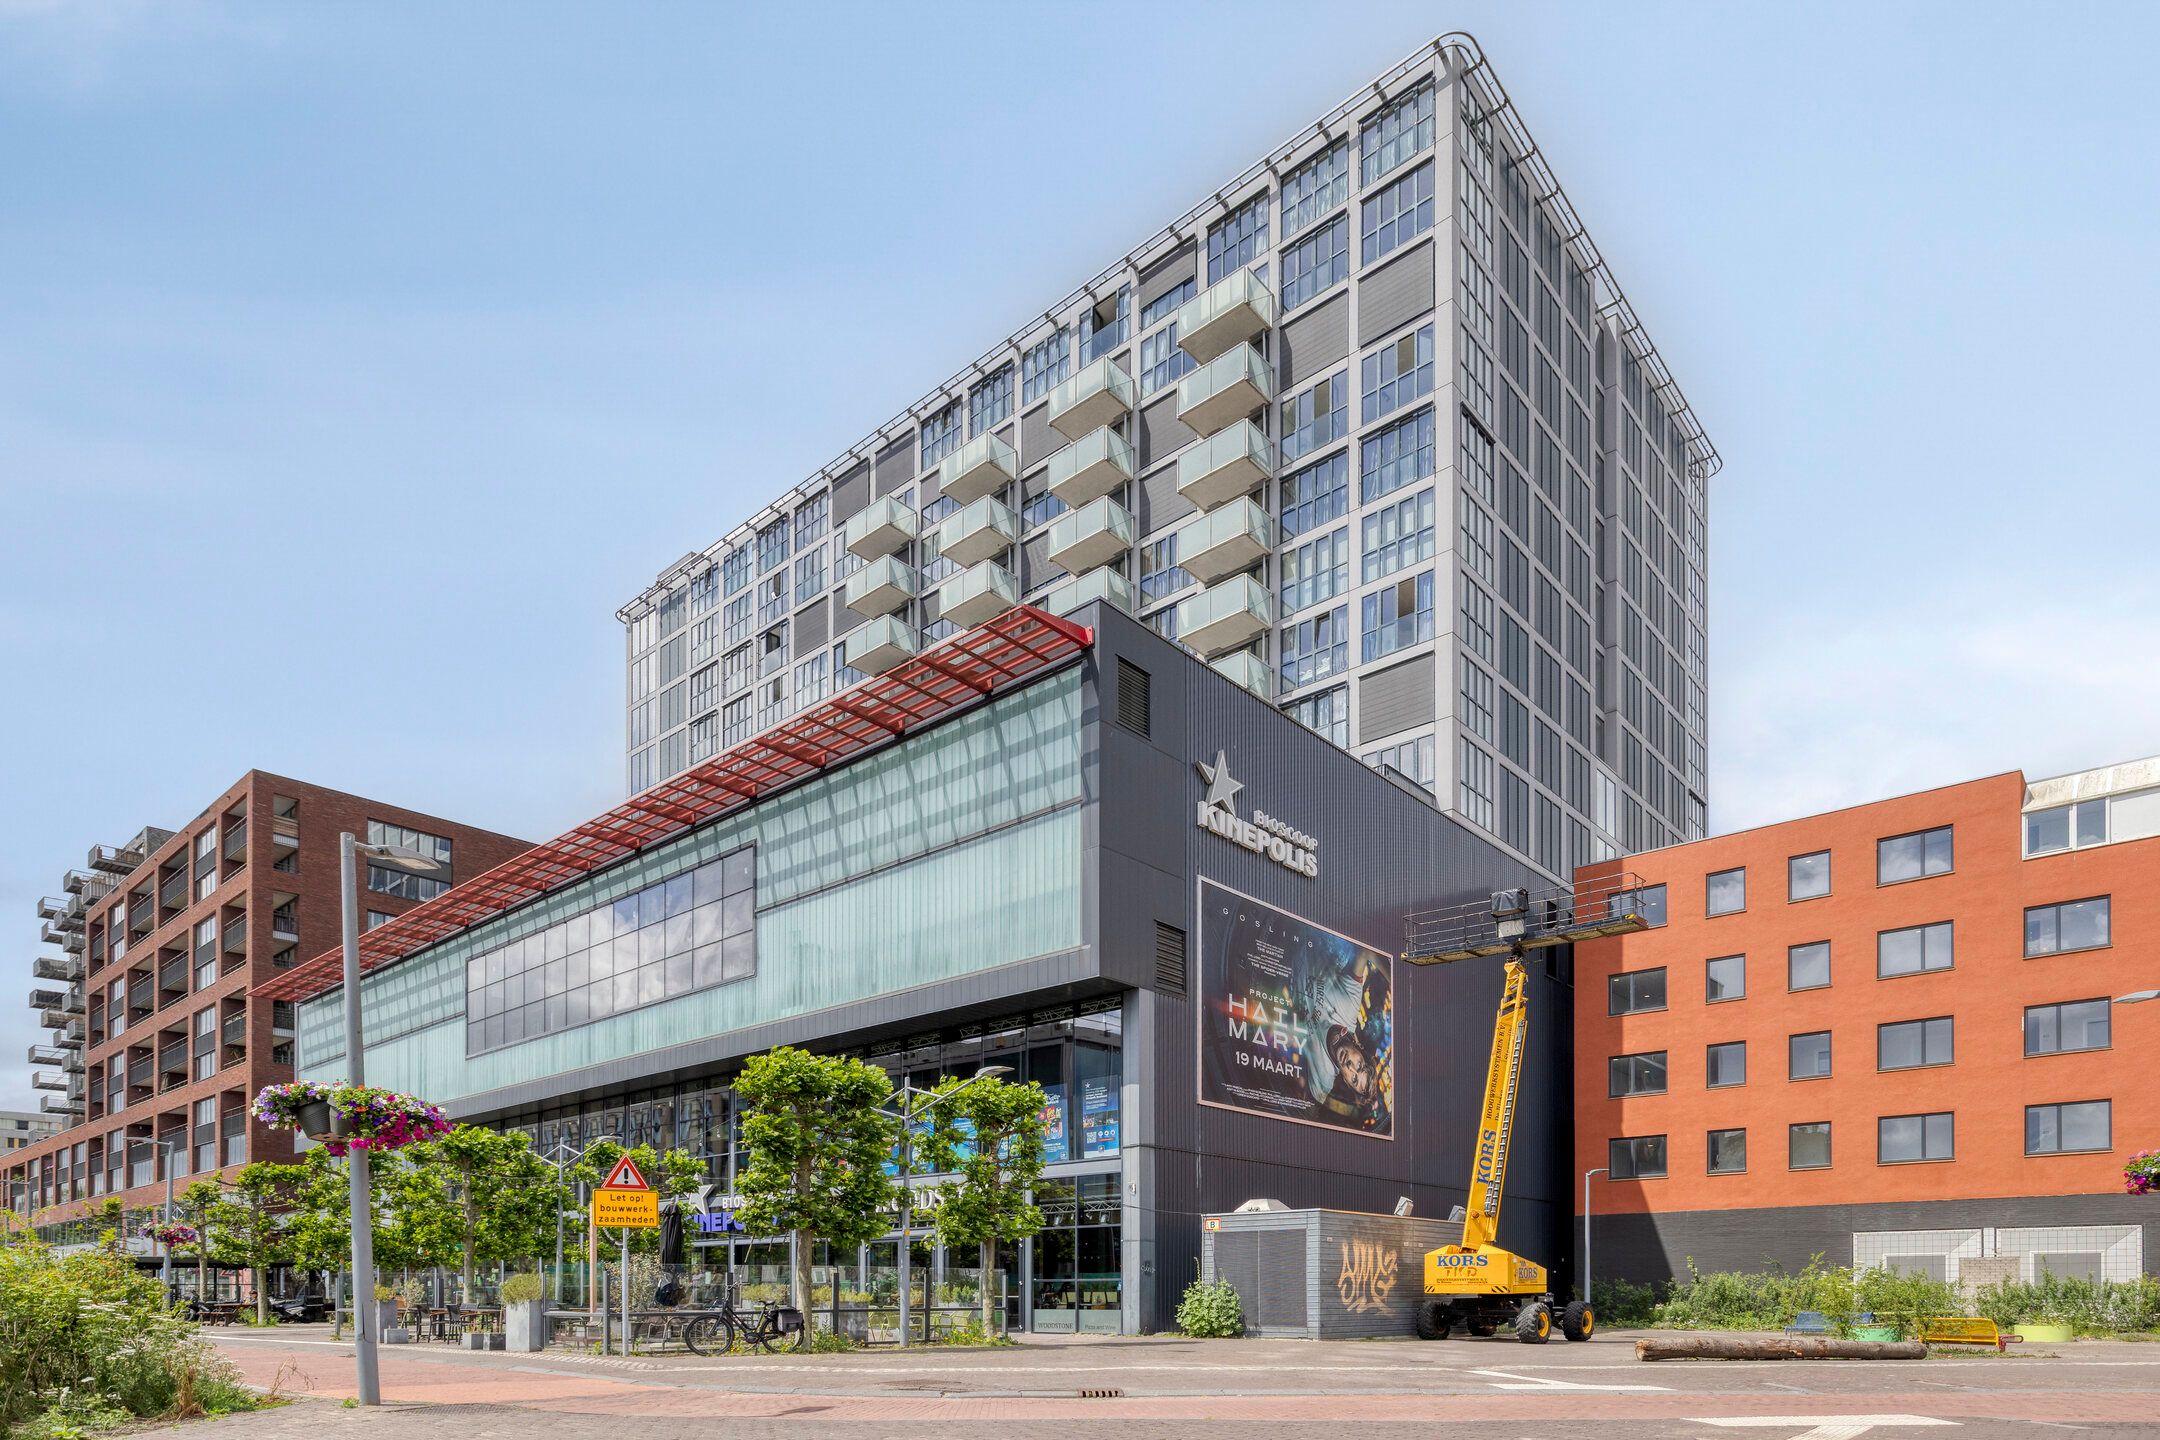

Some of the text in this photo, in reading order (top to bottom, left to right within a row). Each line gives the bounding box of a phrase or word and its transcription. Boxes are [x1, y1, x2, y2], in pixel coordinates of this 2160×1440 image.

[1197, 800, 1318, 877] KINEPOLIS
[1254, 809, 1318, 851] BIOSCOOP
[1222, 907, 1313, 948] GOSLING
[1249, 988, 1292, 1008] PROJECT
[1229, 993, 1308, 1035] HAIL
[1229, 1018, 1308, 1055] MARY
[1235, 1051, 1303, 1078] 19 MAART
[1477, 1129, 1497, 1184] KORS
[600, 1204, 653, 1213] bouwwerk-
[610, 1194, 644, 1203] Let op!
[598, 1216, 655, 1224] zaamheden
[1437, 1254, 1489, 1267] KORS
[1518, 1267, 1538, 1279] KORS
